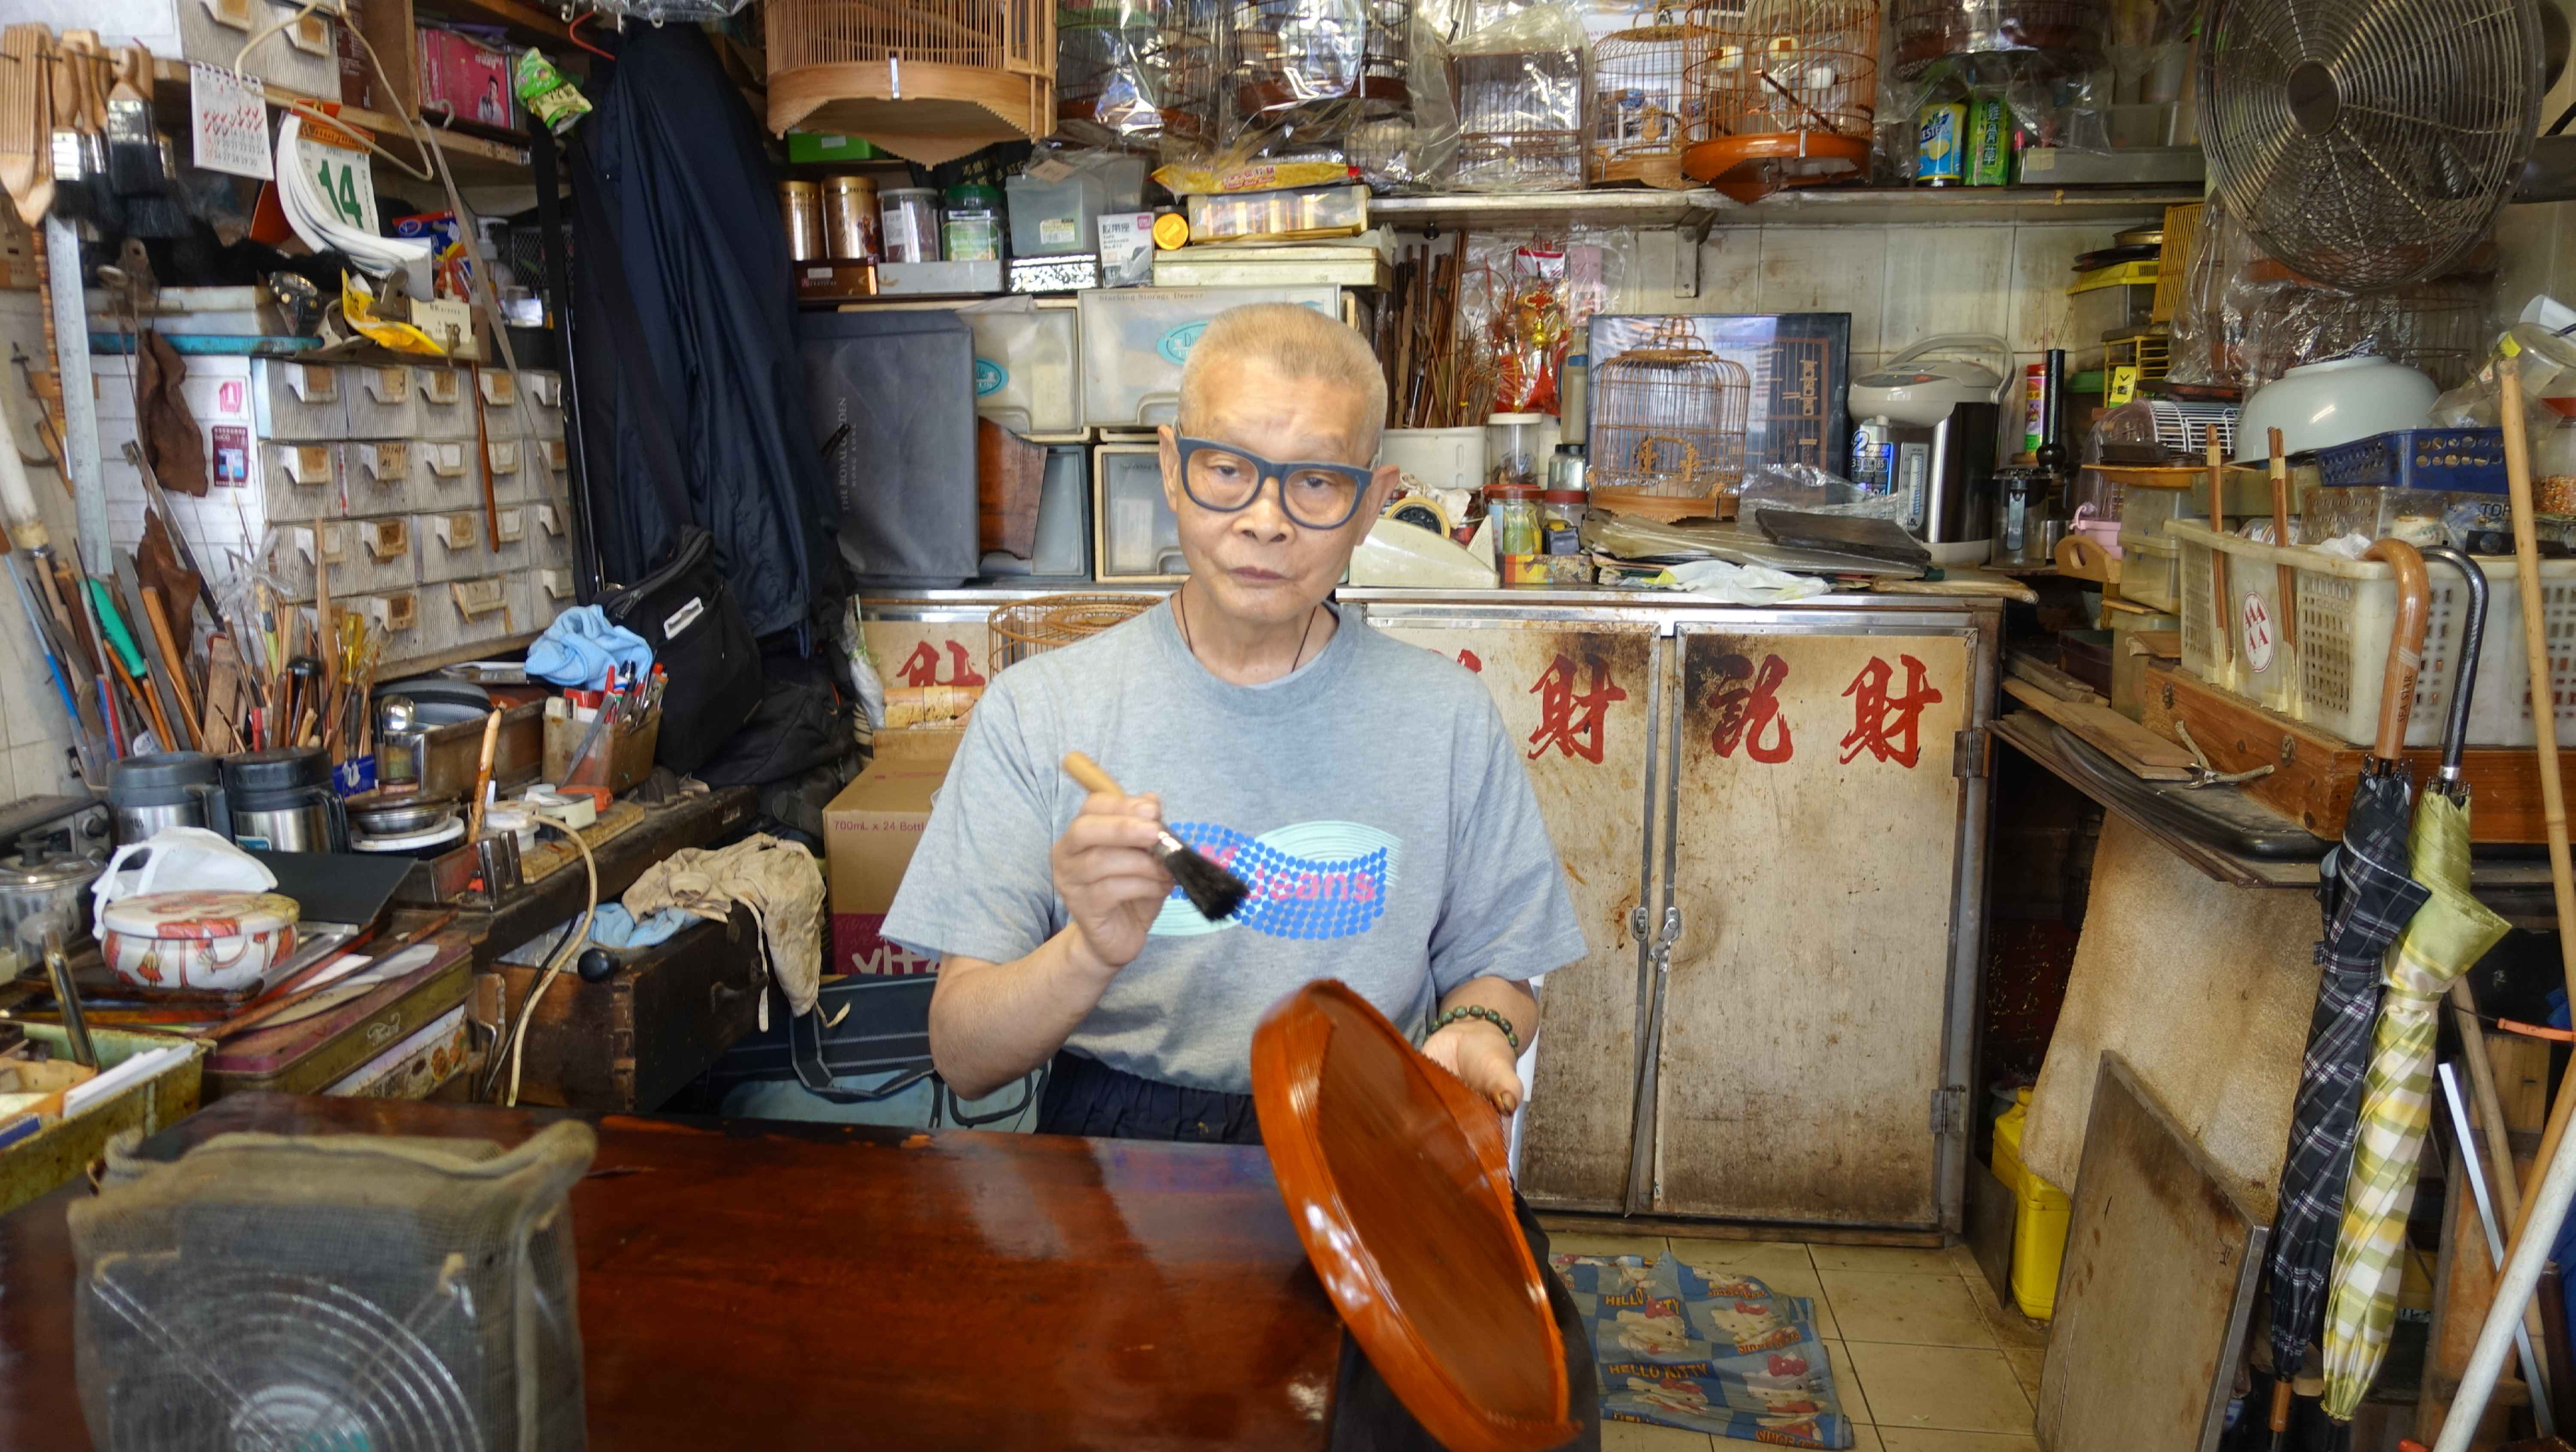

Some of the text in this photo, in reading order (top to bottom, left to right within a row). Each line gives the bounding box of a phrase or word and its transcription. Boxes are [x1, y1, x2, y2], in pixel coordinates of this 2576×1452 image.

[317, 158, 364, 229] 14
[833, 820, 866, 831] 700mL
[883, 821, 895, 831] 24
[900, 820, 926, 832] Bottl
[1604, 1287, 1644, 1306] HELLO
[1608, 1362, 1707, 1379] HELLO KITTY
